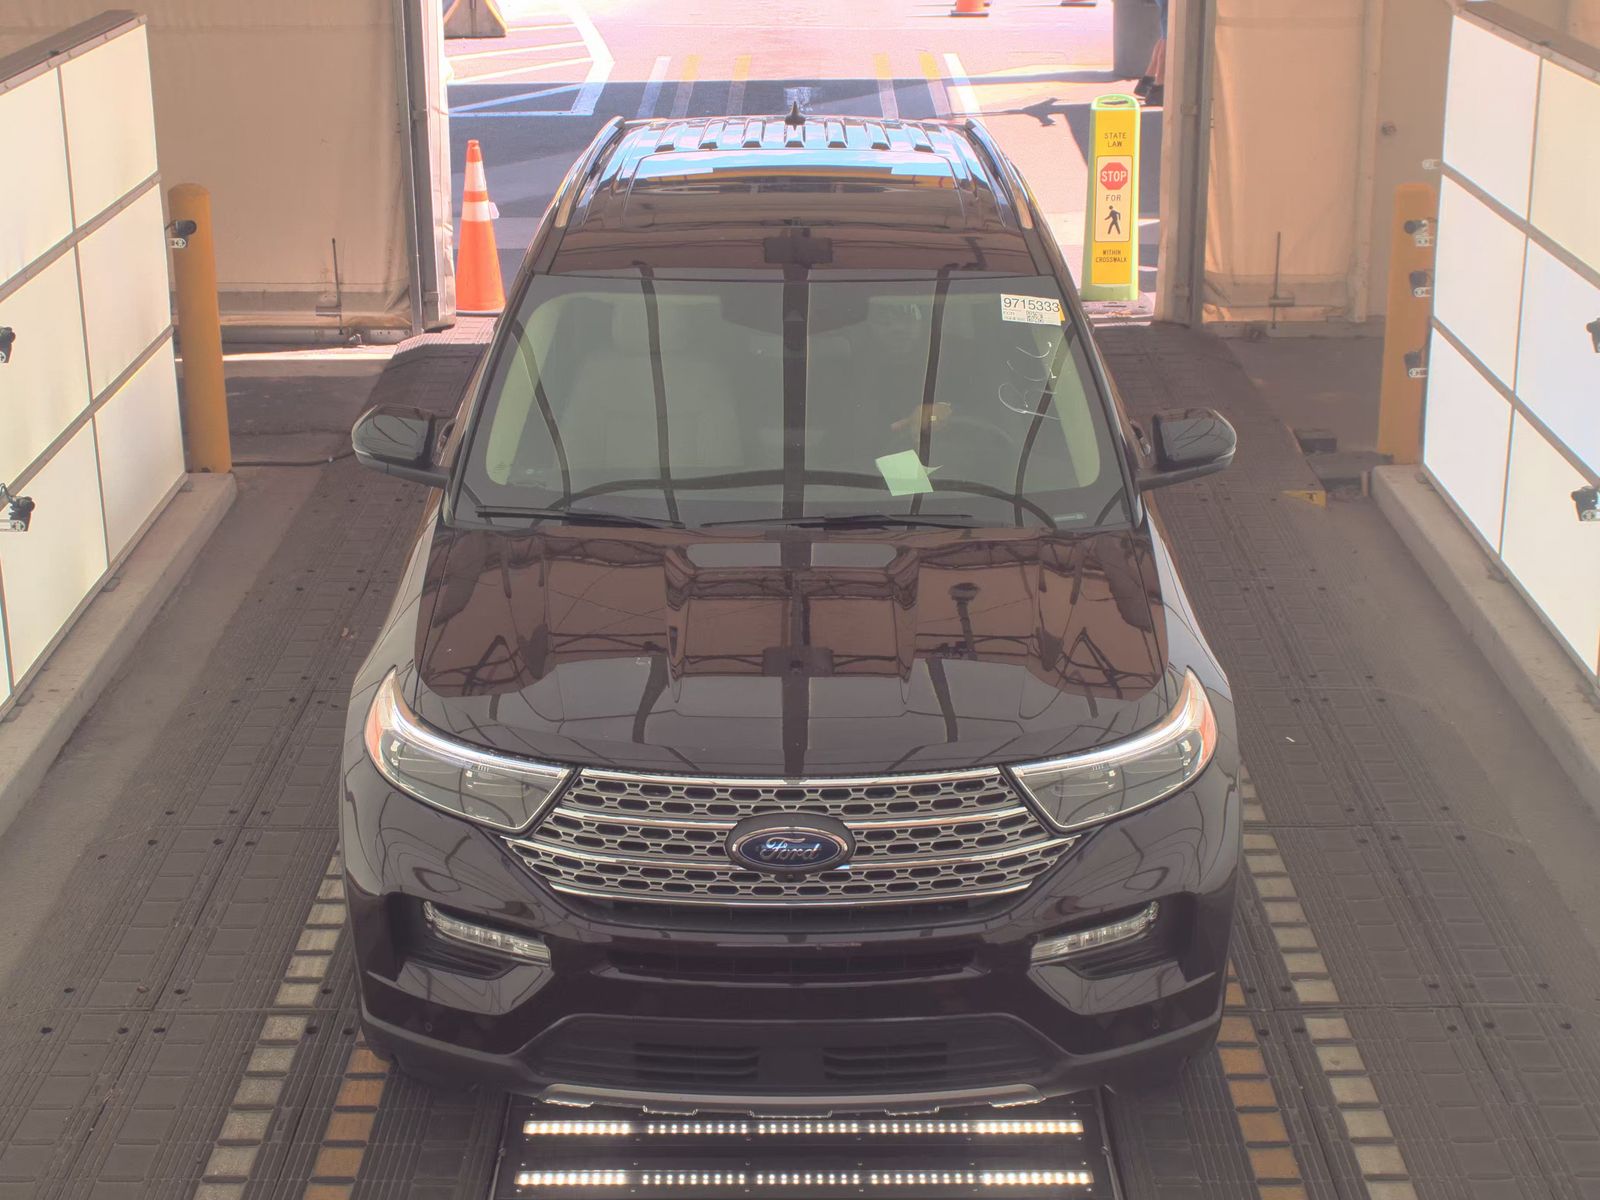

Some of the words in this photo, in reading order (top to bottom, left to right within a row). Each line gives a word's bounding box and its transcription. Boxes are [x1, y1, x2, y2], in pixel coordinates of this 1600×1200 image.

[1107, 140, 1122, 148] LAW
[1101, 170, 1127, 182] STOP
[1105, 194, 1122, 202] FOR
[1003, 297, 1060, 312] 9715333
[760, 836, 821, 860] Ford
